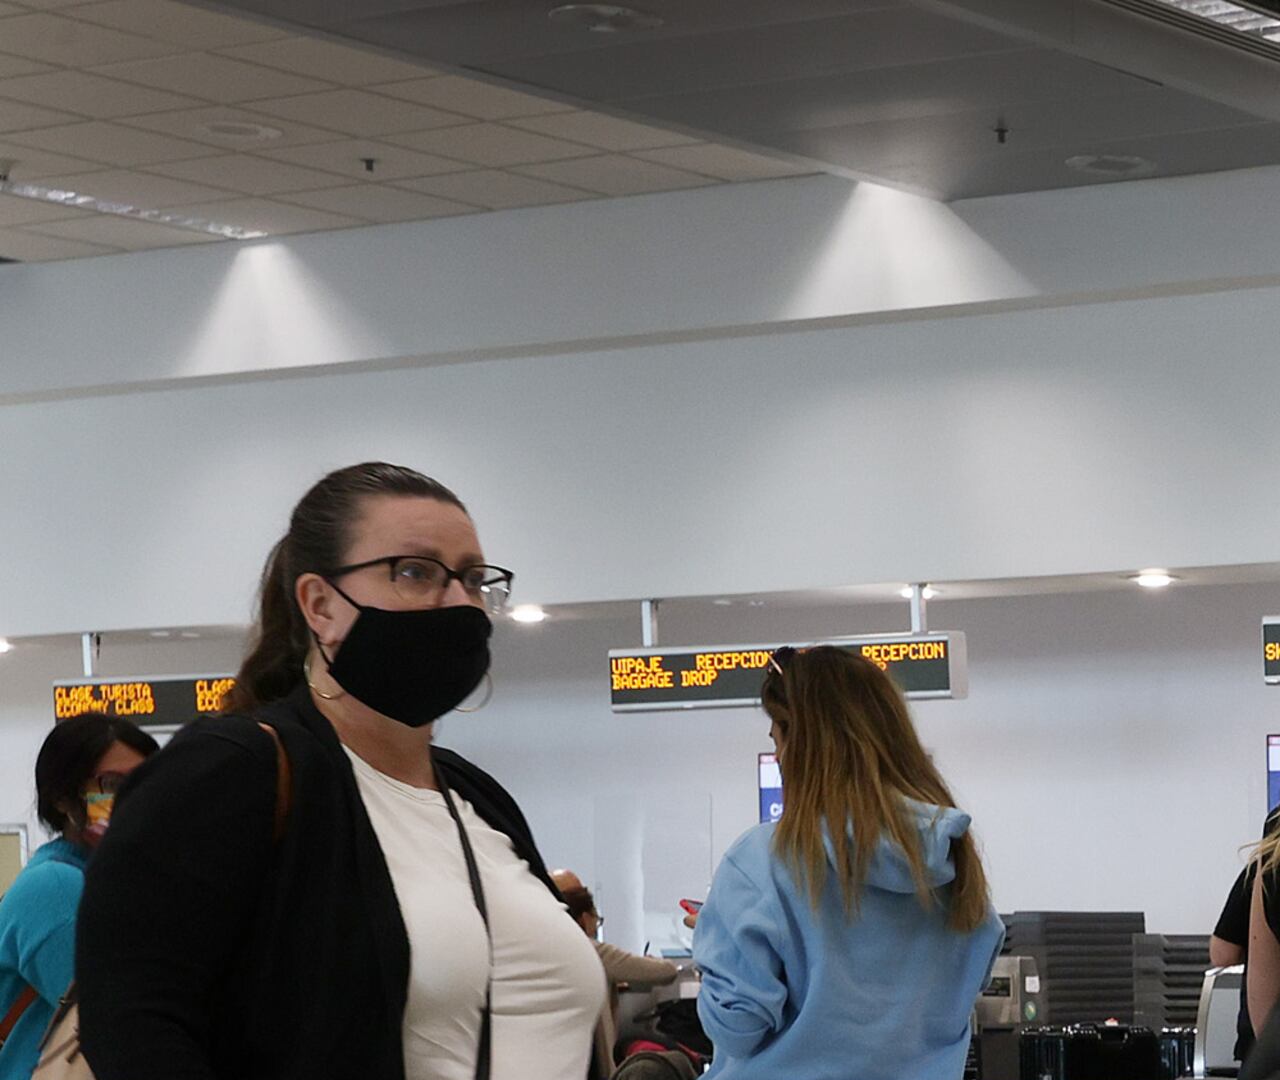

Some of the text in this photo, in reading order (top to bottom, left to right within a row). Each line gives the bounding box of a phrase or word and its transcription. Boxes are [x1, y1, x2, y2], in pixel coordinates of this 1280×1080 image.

[861, 642, 946, 662] RECEPCION
[611, 656, 664, 674] UIPAJE
[611, 669, 719, 691] BAGGAGE DROP
[99, 682, 153, 702] TURISTA
[114, 697, 155, 716] CLASS
